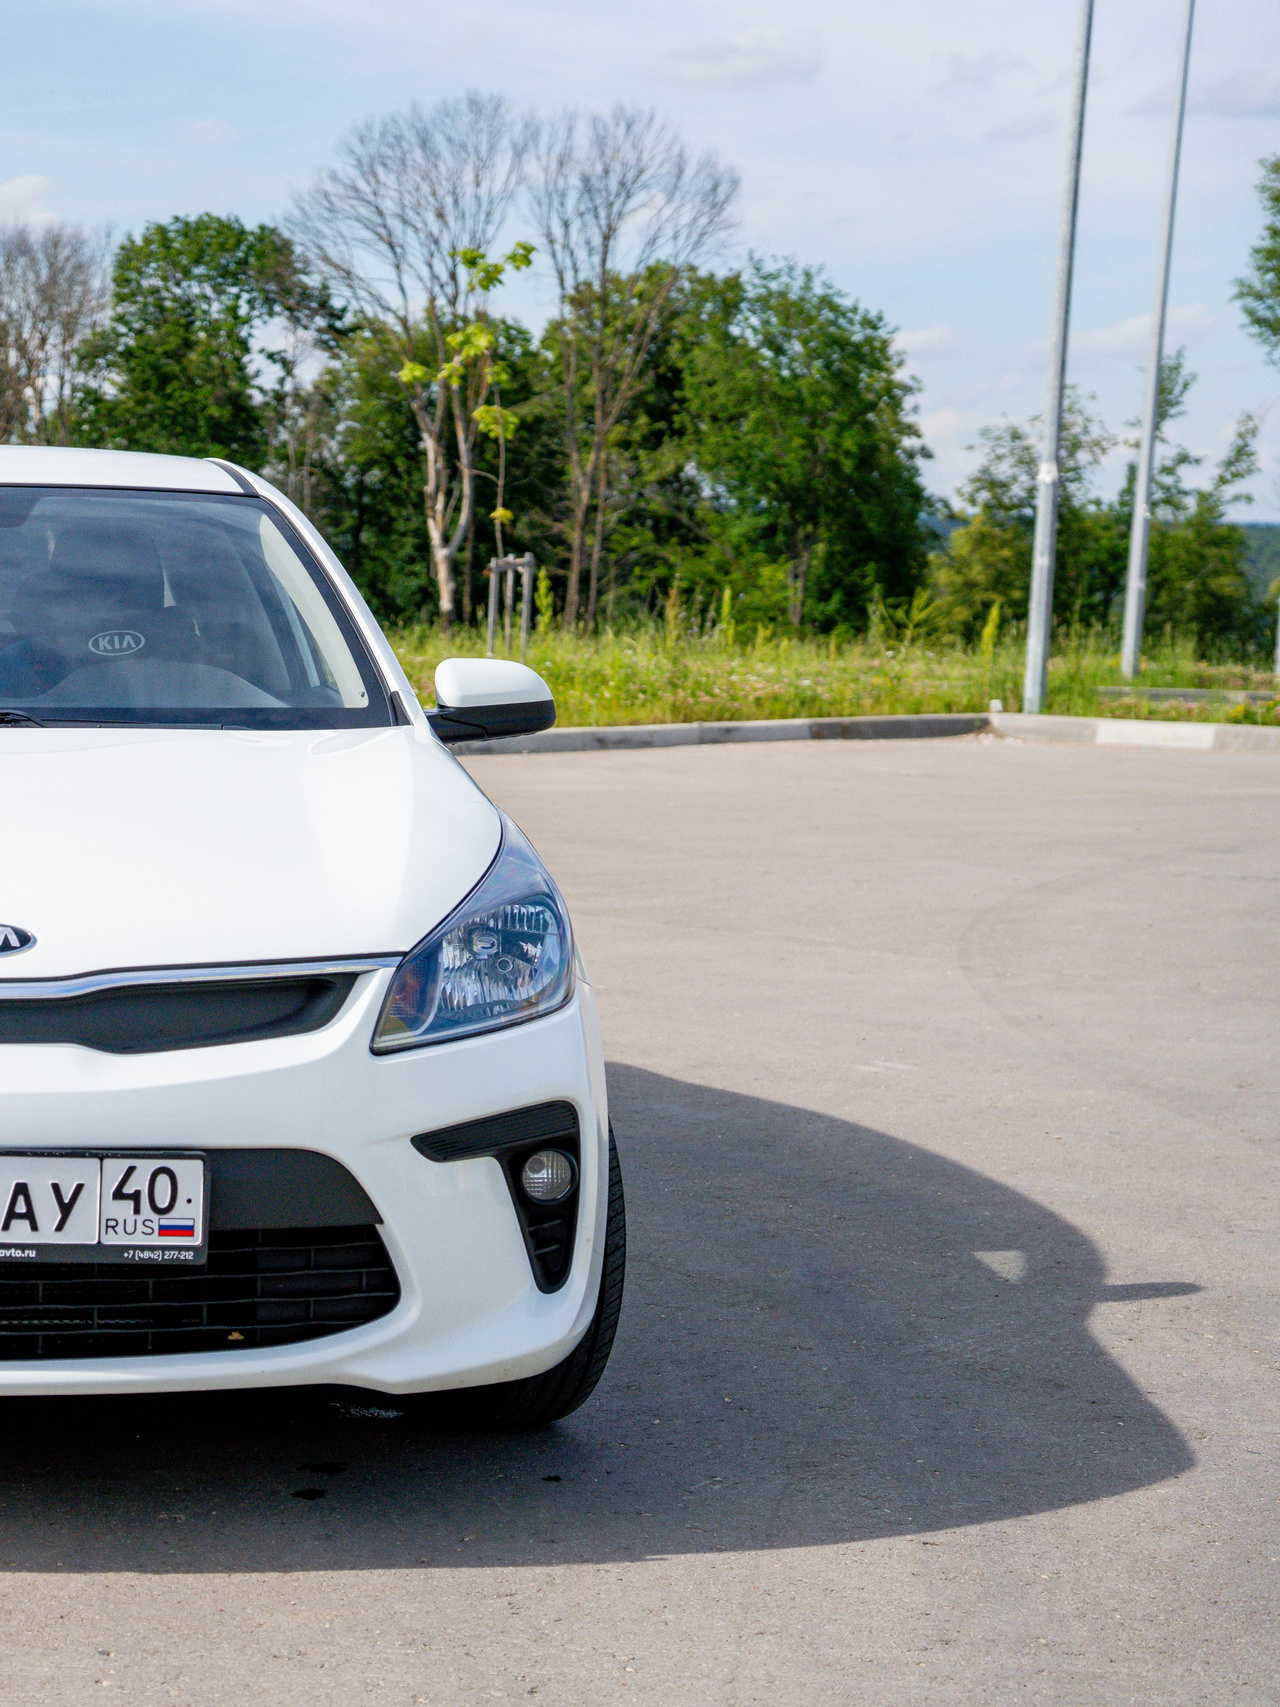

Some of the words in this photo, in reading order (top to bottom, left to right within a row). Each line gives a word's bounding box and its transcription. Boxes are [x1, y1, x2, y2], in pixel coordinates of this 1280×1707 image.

[97, 635, 136, 650] KIA
[111, 1165, 179, 1216] 40
[105, 1218, 155, 1236] RUS
[123, 1250, 134, 1259] +7
[135, 1250, 162, 1261] (4842)
[164, 1250, 194, 1260] 277-212
